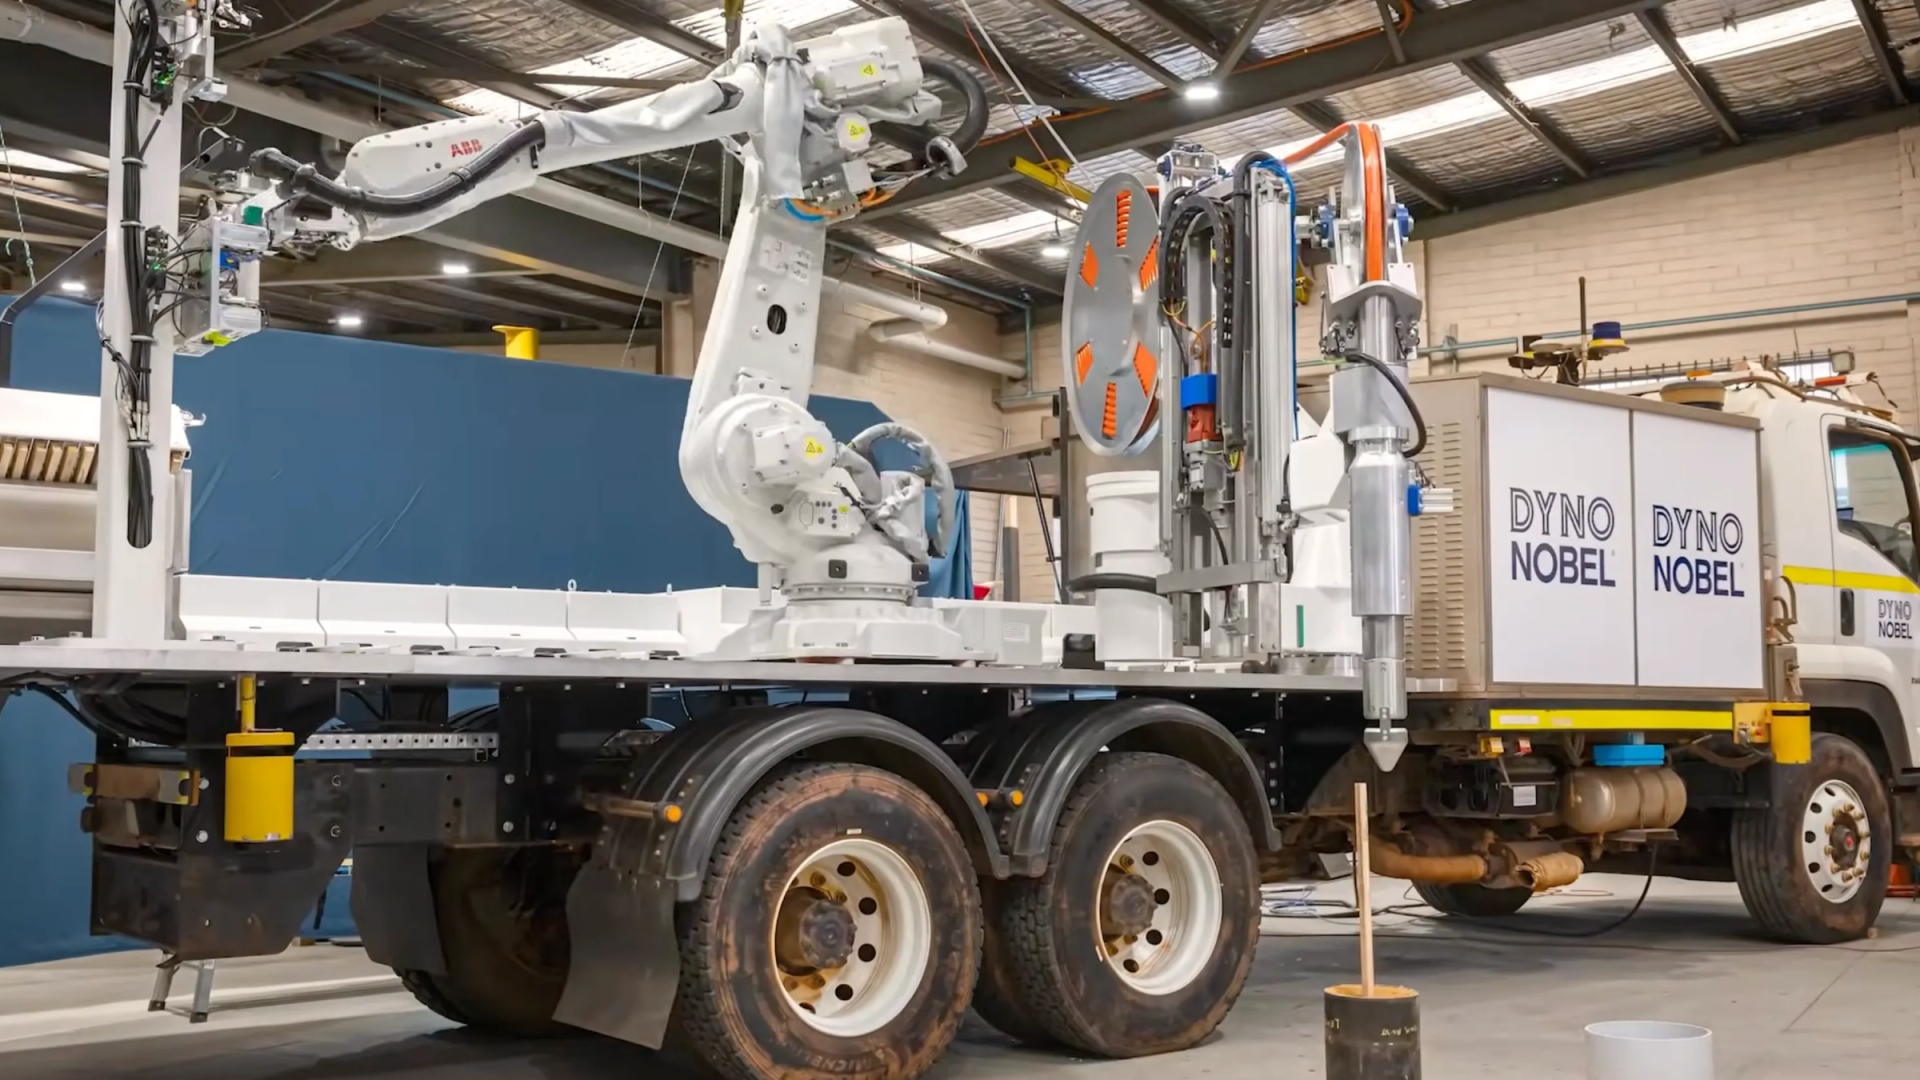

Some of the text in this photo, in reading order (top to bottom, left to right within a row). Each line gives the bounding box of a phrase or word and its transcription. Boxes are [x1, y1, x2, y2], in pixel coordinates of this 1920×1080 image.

[451, 139, 483, 157] ABB
[1509, 487, 1615, 541] DYNO
[1652, 504, 1743, 555] DYNO
[1511, 541, 1616, 587] NOBEL
[1654, 555, 1745, 597] NOBEL
[1878, 599, 1912, 620] DYNO
[1878, 621, 1912, 639] NOBEL
